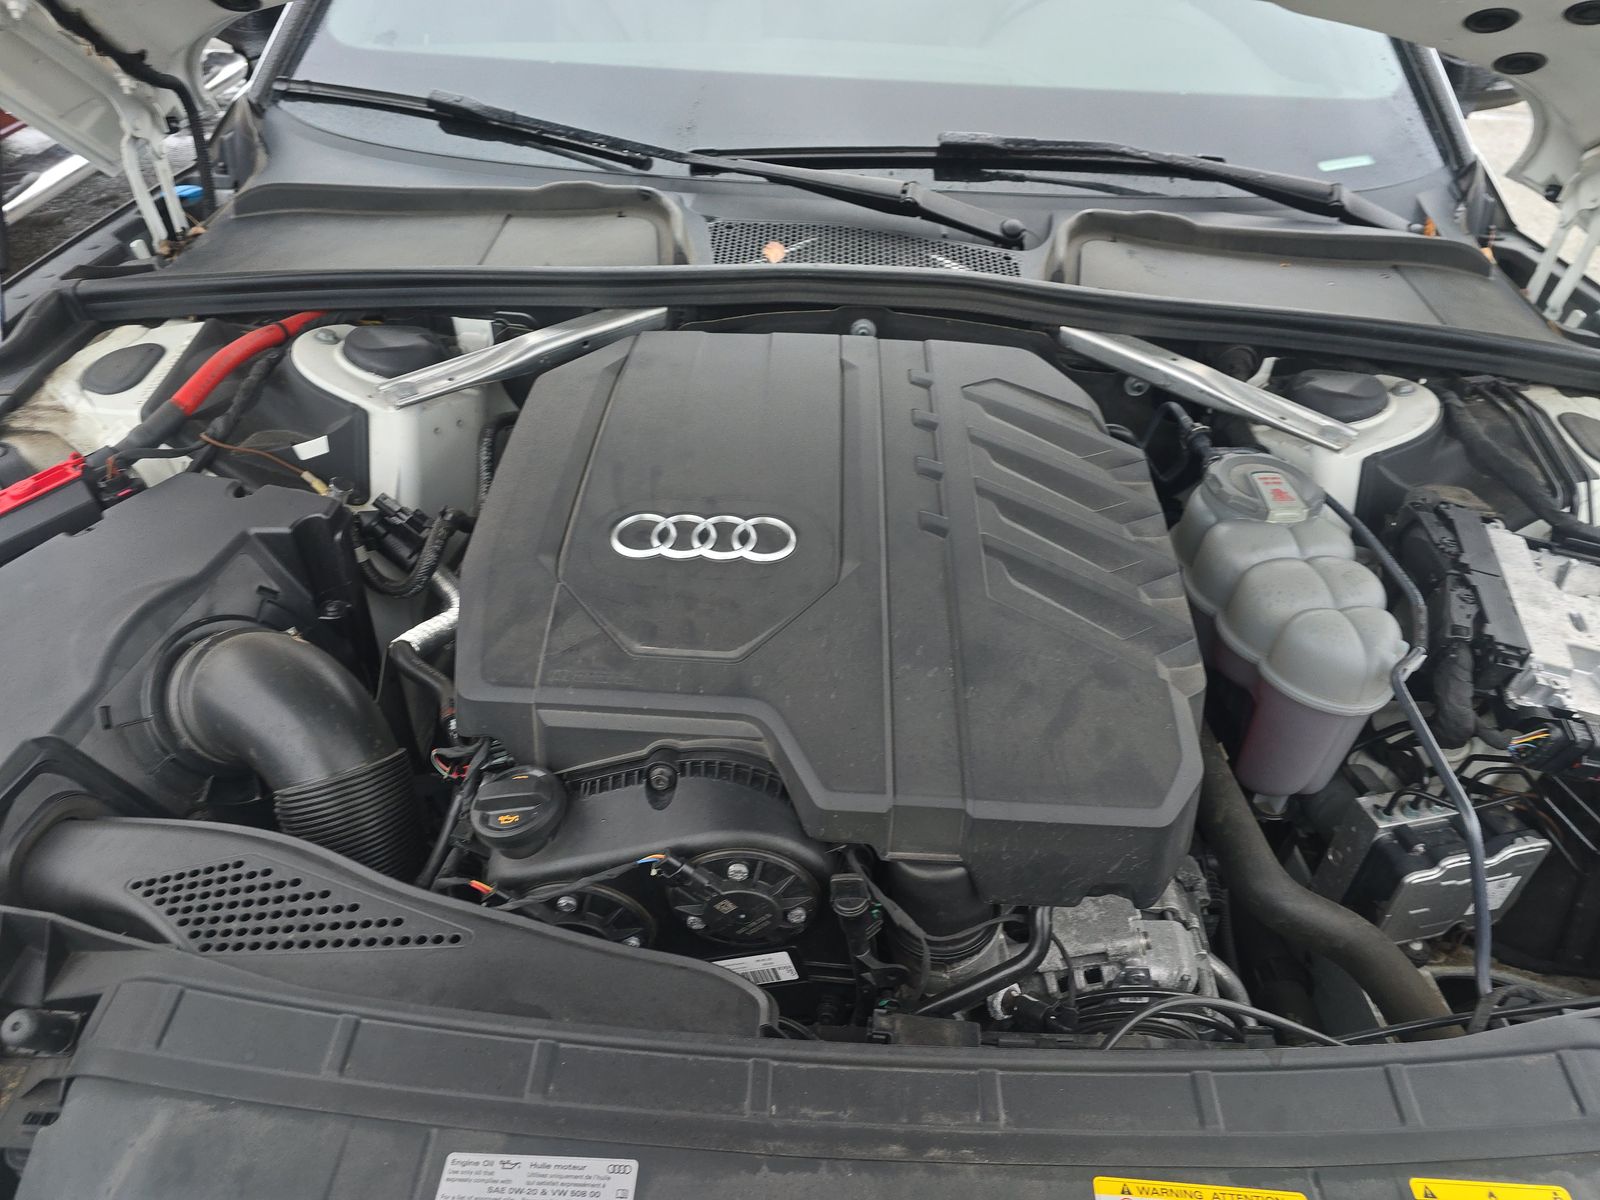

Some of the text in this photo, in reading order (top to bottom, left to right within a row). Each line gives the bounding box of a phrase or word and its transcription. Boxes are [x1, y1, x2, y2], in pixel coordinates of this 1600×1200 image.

[451, 1158, 480, 1167] Engine
[530, 1161, 552, 1169] Huile
[487, 1185, 507, 1193] SAE
[540, 1188, 548, 1196] &
[1136, 1186, 1281, 1200] WARNING ATTEN
